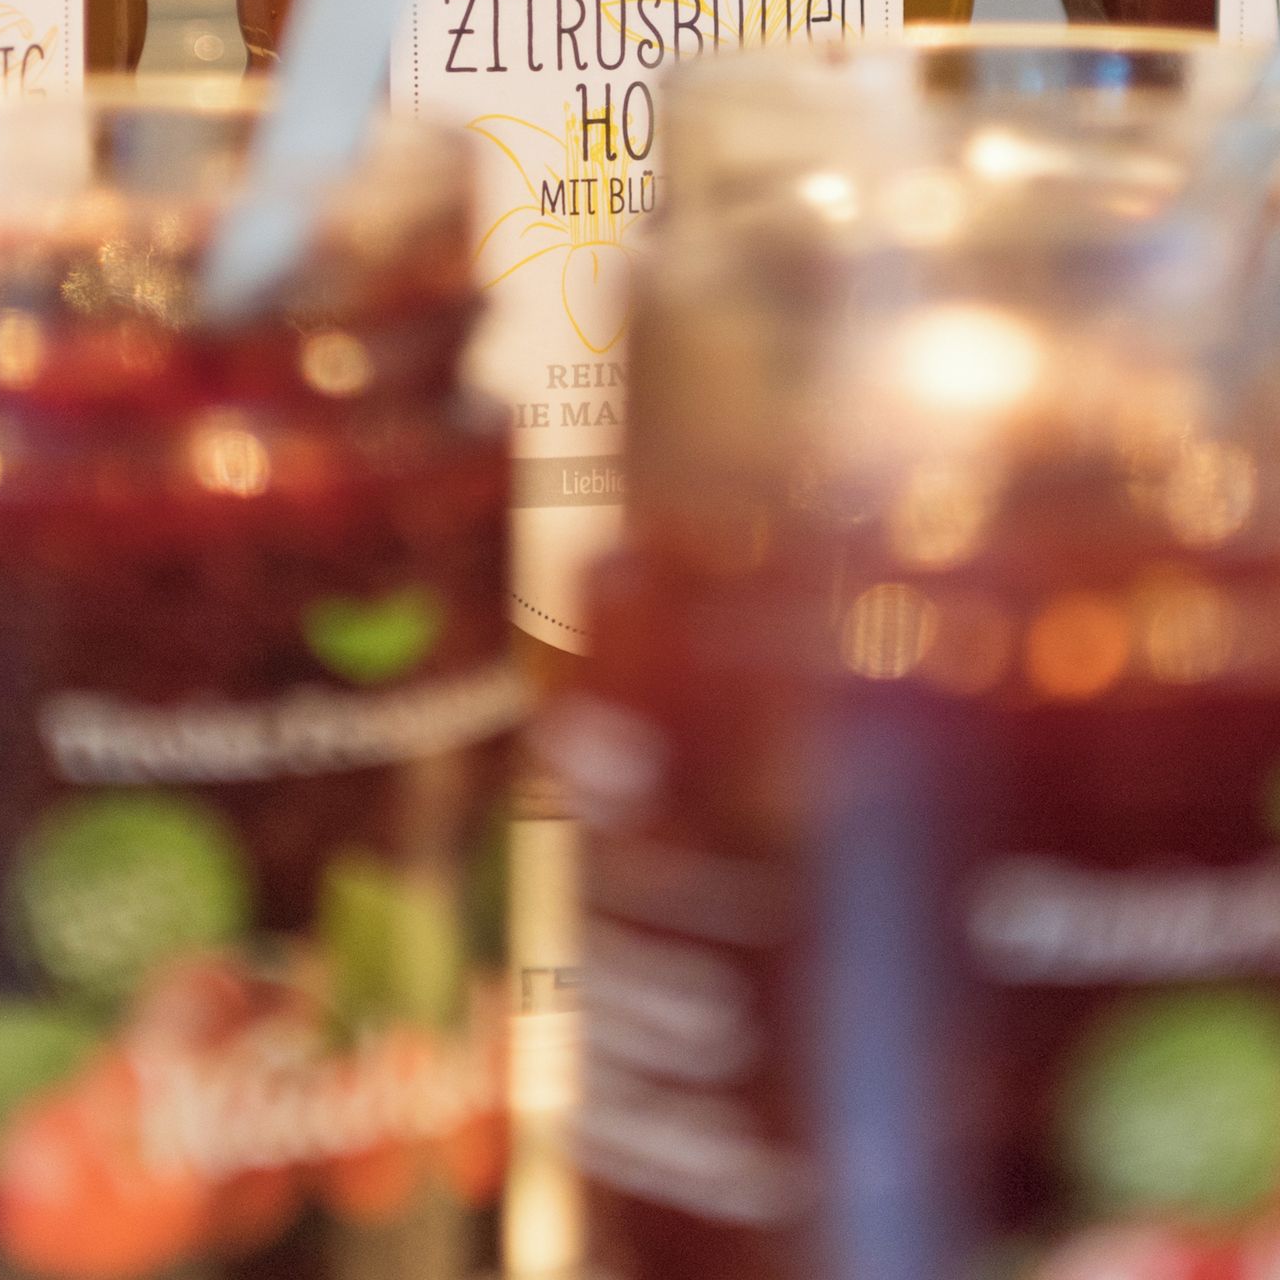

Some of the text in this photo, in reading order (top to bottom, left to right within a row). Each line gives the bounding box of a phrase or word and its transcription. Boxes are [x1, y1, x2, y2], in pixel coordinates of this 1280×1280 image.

[541, 169, 657, 217] MIT BLÜ
[516, 400, 622, 430] IE MA
